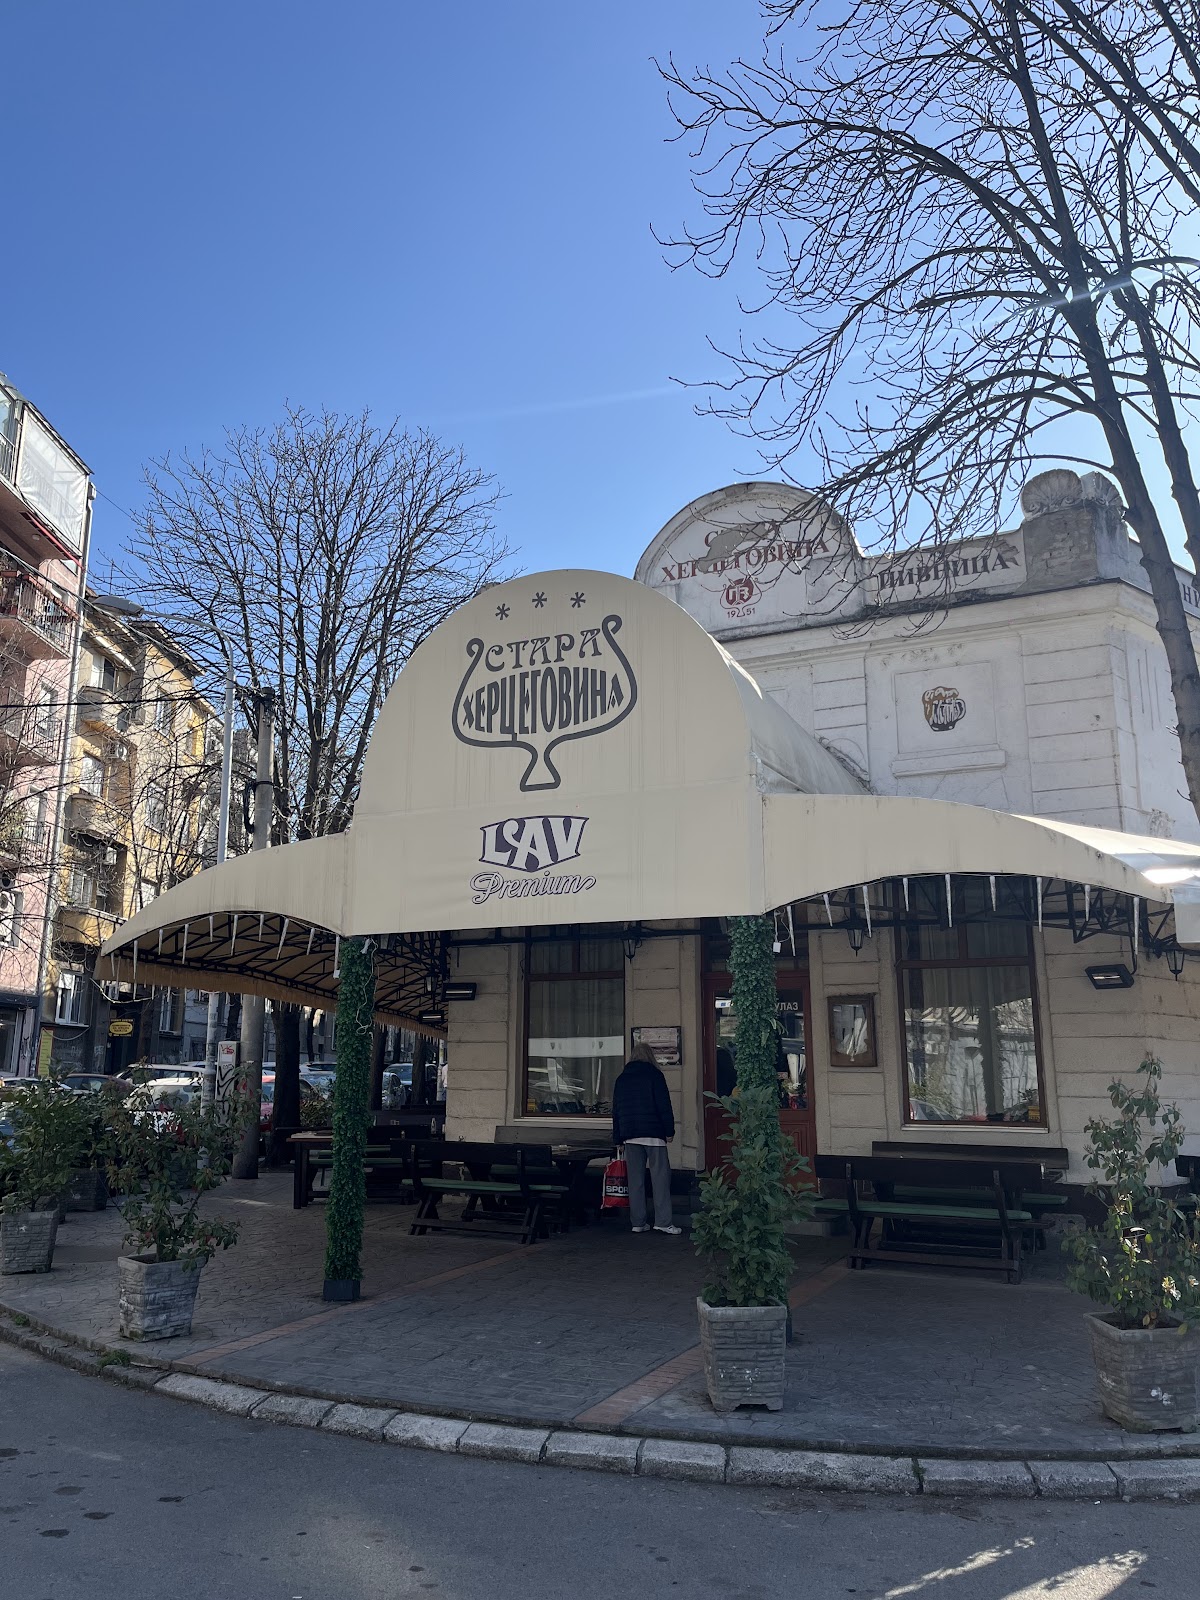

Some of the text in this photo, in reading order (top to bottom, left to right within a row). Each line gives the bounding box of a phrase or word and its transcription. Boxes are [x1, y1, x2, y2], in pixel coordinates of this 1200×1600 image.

[662, 537, 830, 583] ХЕЦЕГОВИНА
[485, 628, 603, 673] СТАРА
[462, 666, 625, 742] ХЕРЦЕГОВИНА
[480, 816, 588, 872] LAV
[470, 870, 597, 905] Premium
